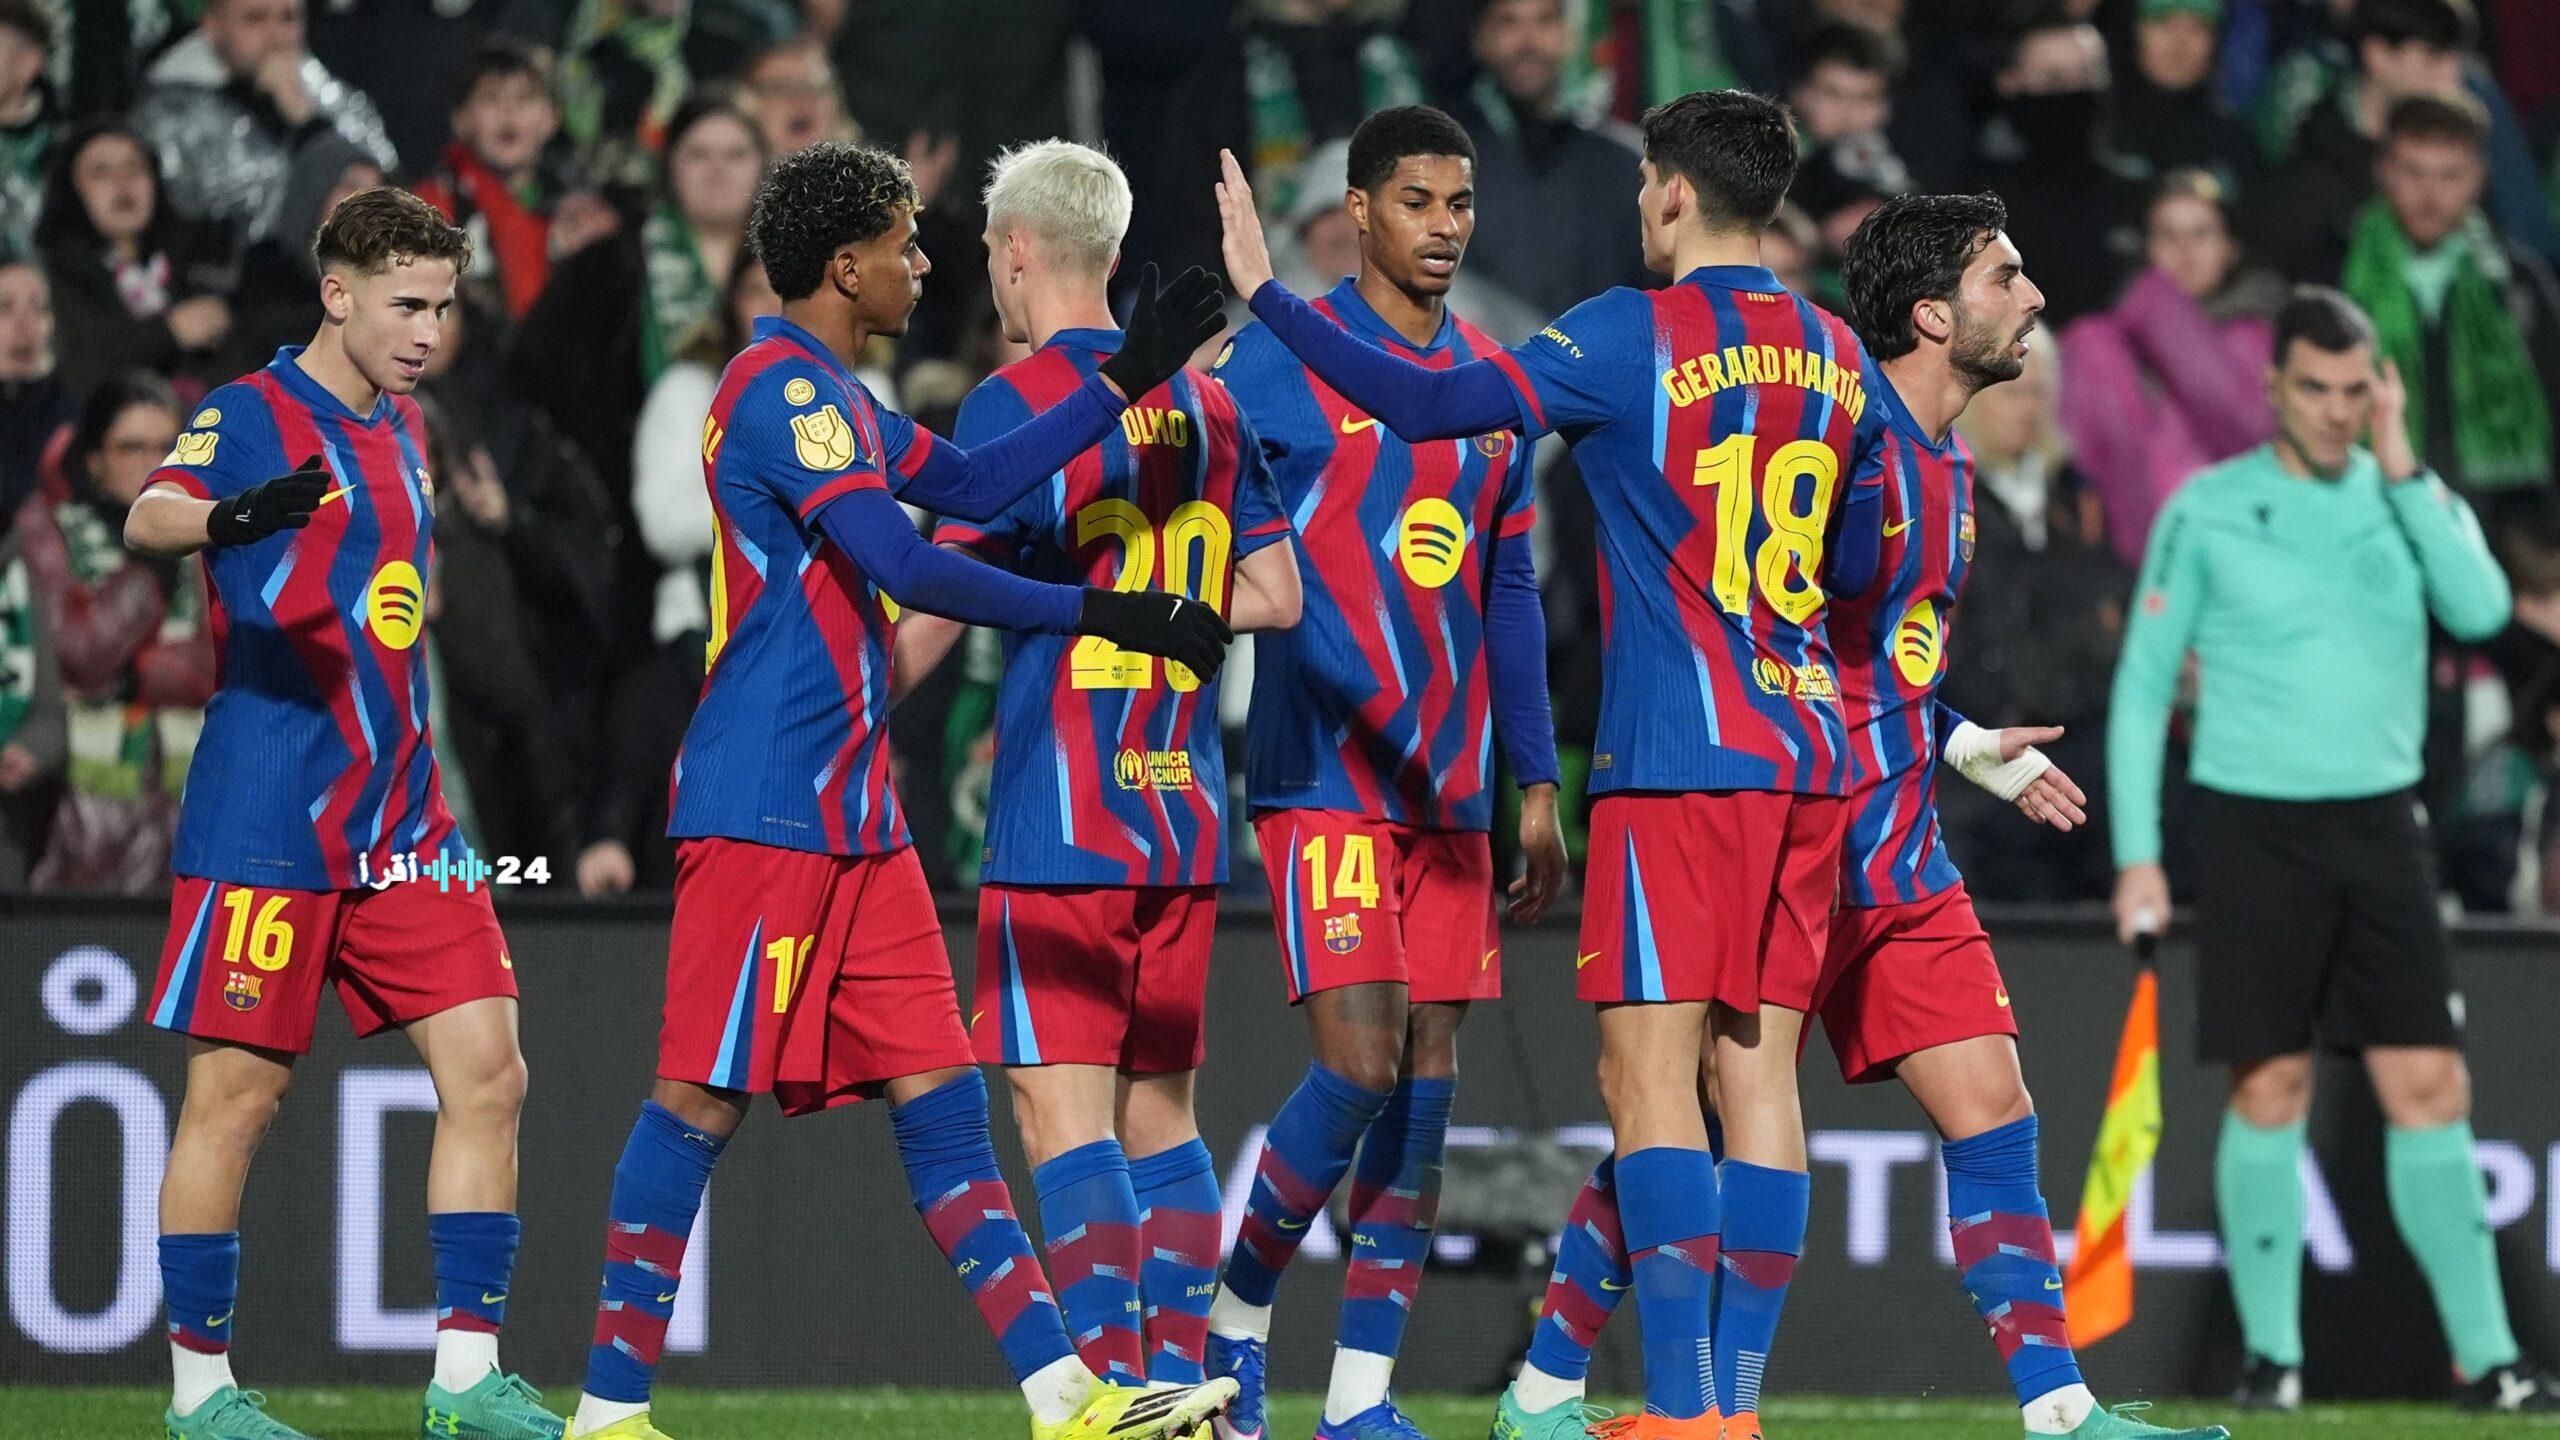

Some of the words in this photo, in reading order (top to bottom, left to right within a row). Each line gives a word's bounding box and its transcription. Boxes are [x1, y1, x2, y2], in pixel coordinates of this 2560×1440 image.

[792, 386, 808, 397] 32
[1661, 345, 1781, 408] GERARD
[1784, 347, 1867, 425] MARTÍN
[1120, 406, 1188, 448] OLMO
[1693, 433, 1838, 625] 18
[1070, 497, 1233, 693] 20
[1146, 750, 1191, 767] UNHCR
[1149, 767, 1193, 784] ACNUR
[1302, 834, 1380, 911] 14
[223, 888, 294, 971] 16
